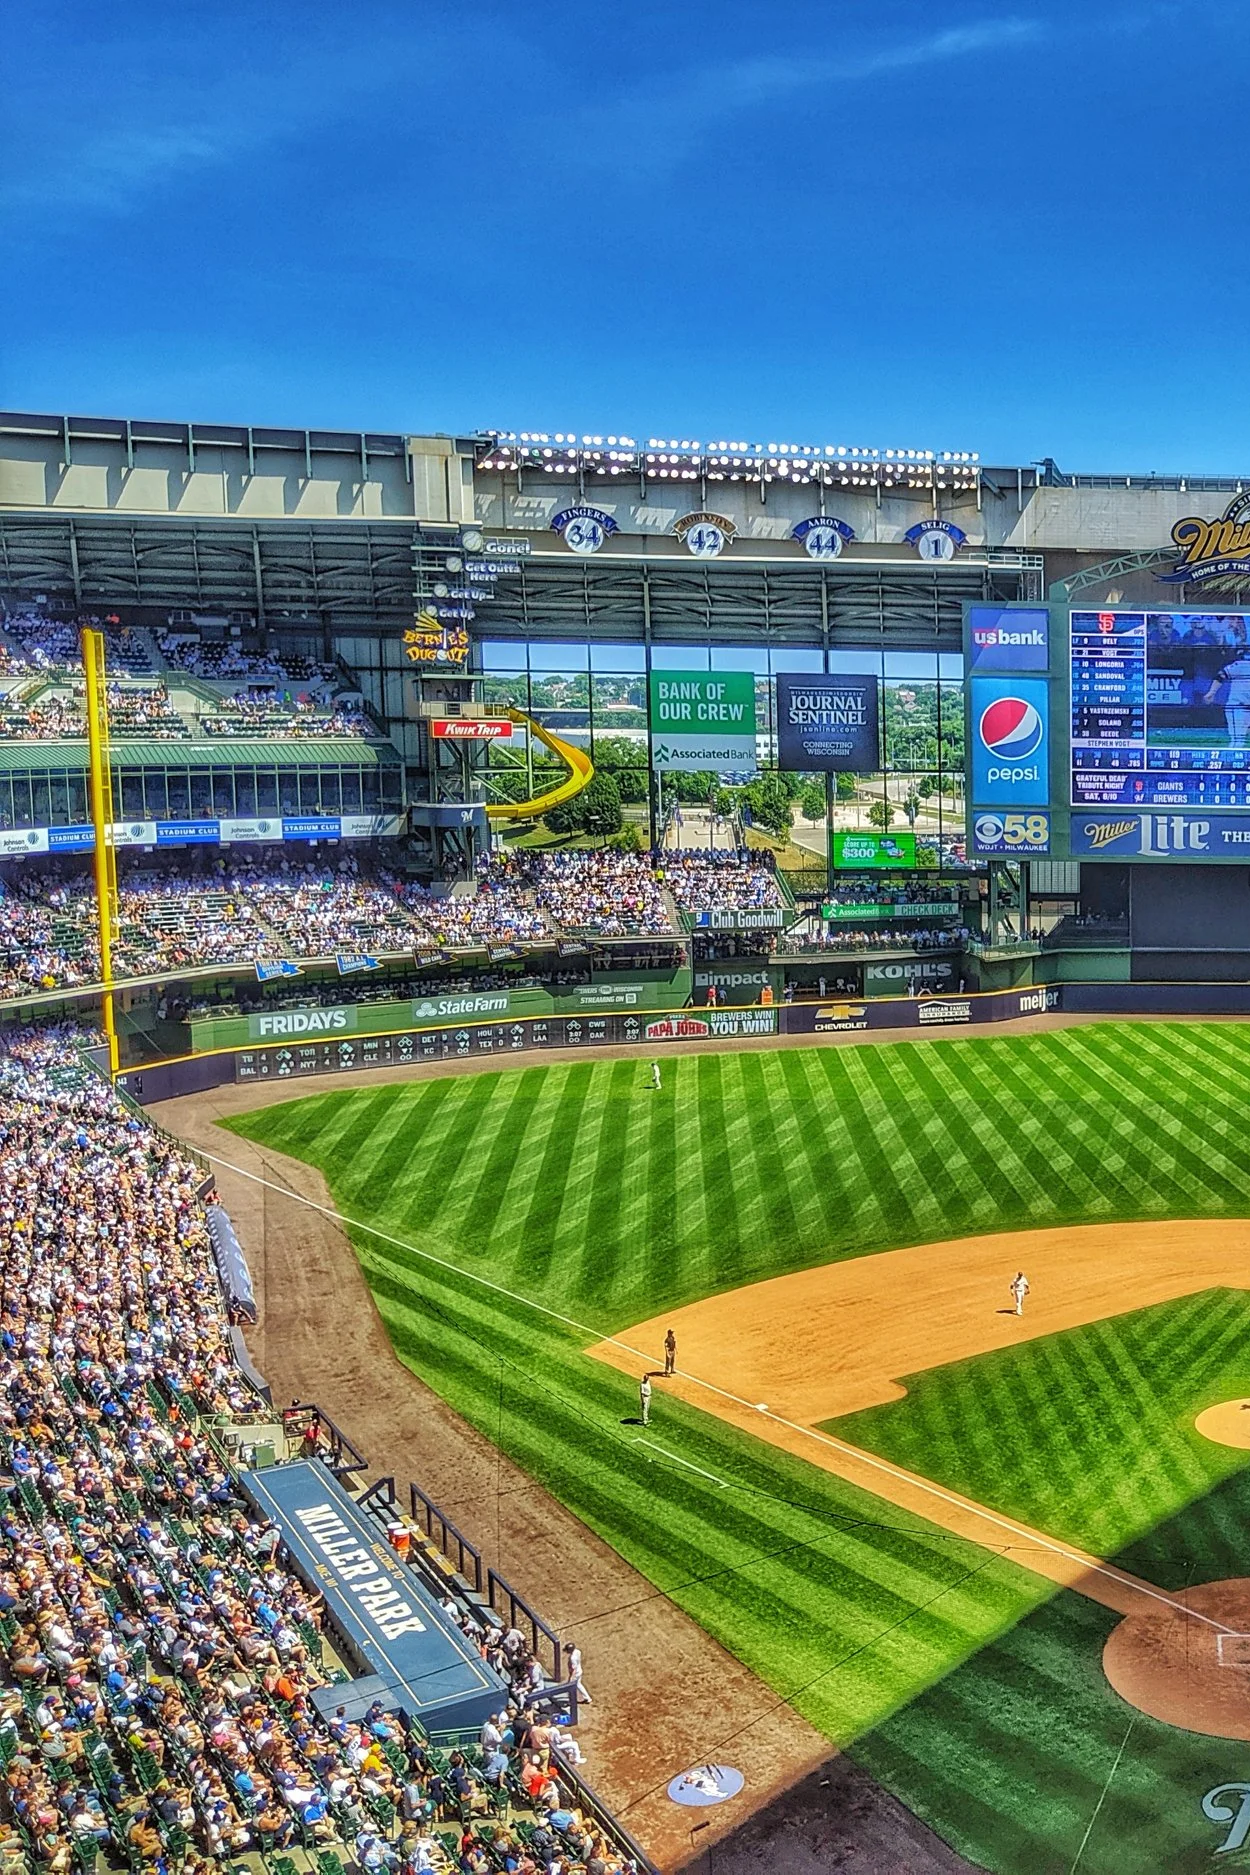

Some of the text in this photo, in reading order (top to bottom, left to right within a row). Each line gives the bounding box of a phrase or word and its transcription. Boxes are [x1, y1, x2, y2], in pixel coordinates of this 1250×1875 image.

[561, 508, 607, 522] FINGERS
[680, 513, 730, 529] ROBINSON
[808, 518, 841, 529] AARON
[921, 521, 950, 532] SELIG
[569, 525, 600, 545] 34
[691, 529, 720, 550] 42
[486, 542, 530, 554] Gone!
[810, 534, 838, 555] 44
[931, 538, 942, 558] 1
[1191, 565, 1216, 579] HOME
[1218, 563, 1230, 571] OF
[1232, 562, 1250, 571] THE
[659, 682, 726, 700] BANK OF
[788, 695, 867, 711] JOURNAL
[660, 703, 744, 721] OUR CREW
[788, 710, 867, 726] SENTINEL
[803, 741, 854, 749] CONNECTING
[806, 748, 850, 756] WISCONSIN
[1087, 740, 1130, 748] STEPHEN VOGT
[987, 765, 1040, 784] pepsi
[284, 824, 318, 832] STADIUM
[1003, 815, 1049, 844] 58
[1084, 820, 1140, 845] Miller
[1136, 814, 1210, 857] Lite
[901, 904, 955, 916] CHECK DECK
[711, 910, 783, 928] Club Goodwill
[708, 970, 769, 988] impact
[866, 963, 952, 980] KOHL'S
[1020, 990, 1059, 1012] meijer
[259, 1010, 346, 1036] FRIDAYS
[710, 1010, 774, 1022] BREWERS WIN!
[478, 1029, 492, 1038] HOU
[710, 1020, 774, 1035] YOU WIN!
[814, 1022, 868, 1032] CHEVROLET
[363, 1040, 390, 1050] MIN 3
[422, 1036, 436, 1044] DET
[478, 1039, 492, 1048] TEX
[364, 1052, 391, 1062] CLE 3
[240, 1066, 268, 1076] BAL 0
[370, 1542, 406, 1580] WELCOME TO
[294, 1503, 428, 1642] MILLER PARK
